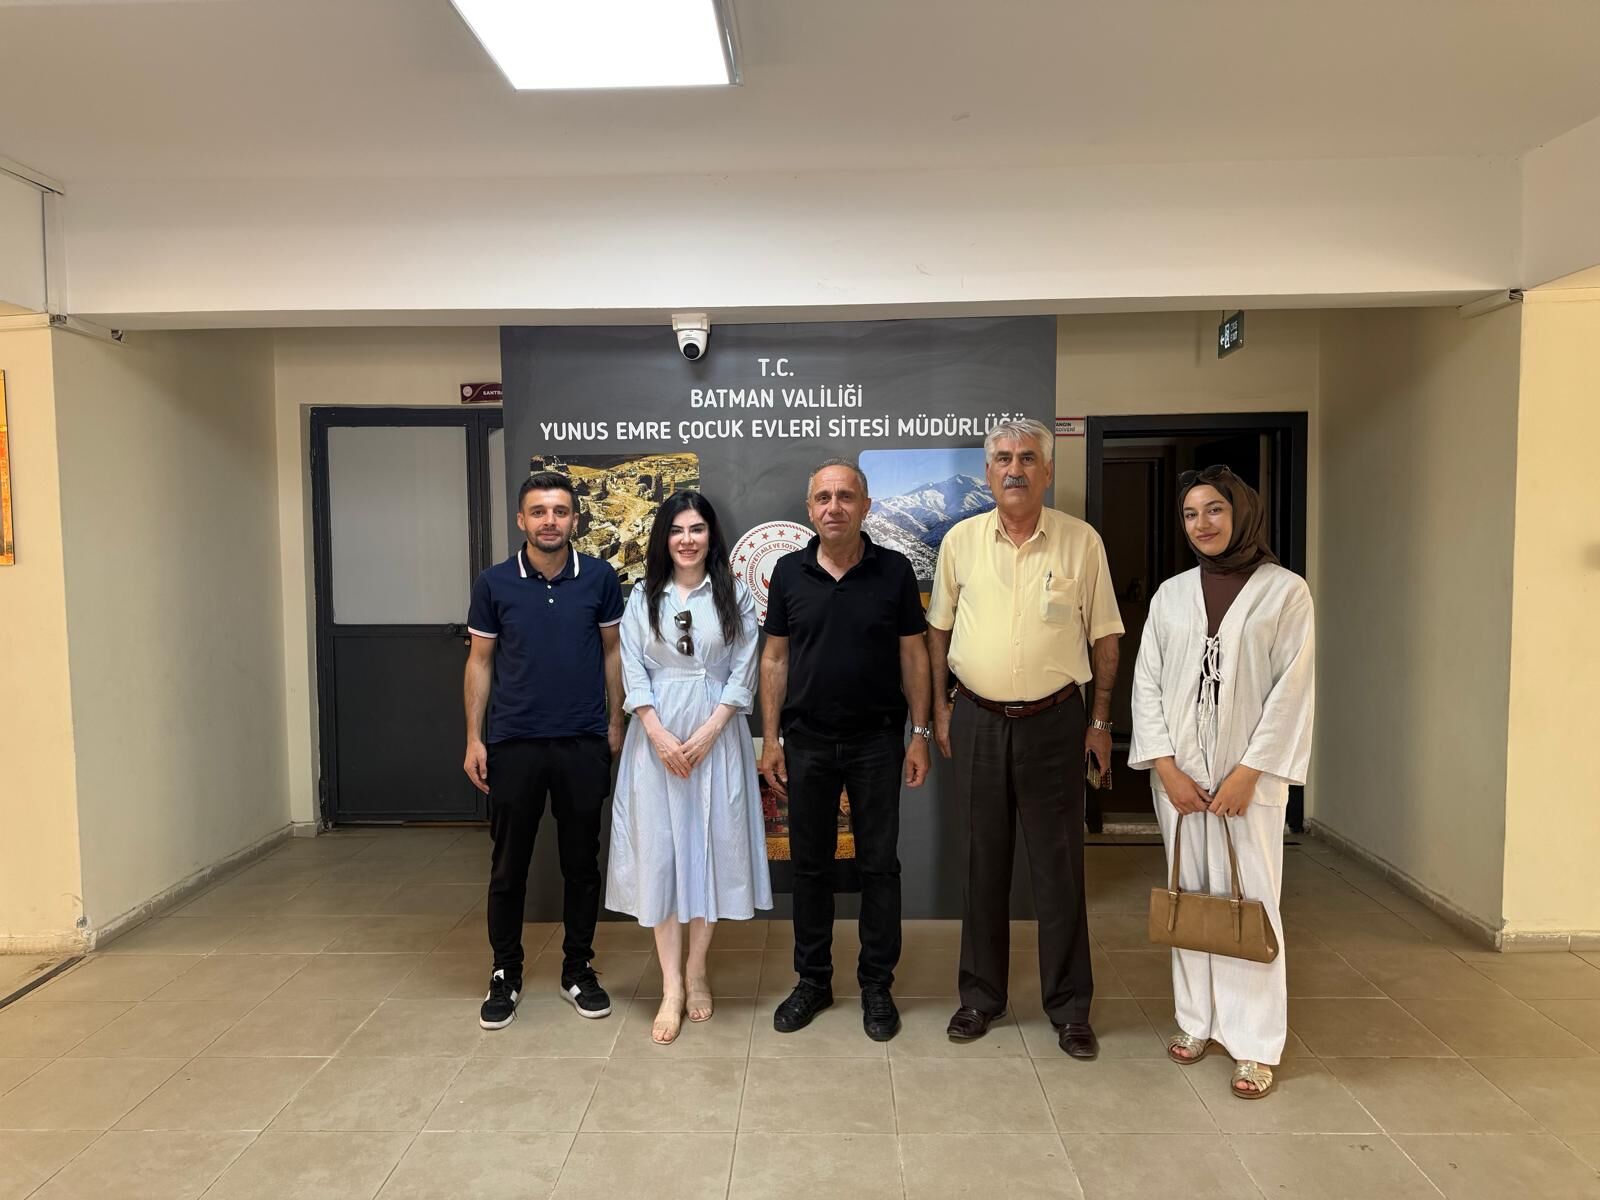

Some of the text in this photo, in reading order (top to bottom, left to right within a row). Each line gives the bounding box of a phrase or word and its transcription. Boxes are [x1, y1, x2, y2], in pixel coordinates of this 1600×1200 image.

[757, 357, 795, 377] T.C.
[690, 383, 863, 409] BATMAN VALİLİĞİ
[539, 412, 1026, 445] YUNUS EMRE ÇOCUK EVLERİ SİTESİ MÜDÜRLÜ
[760, 544, 773, 554] AİLE
